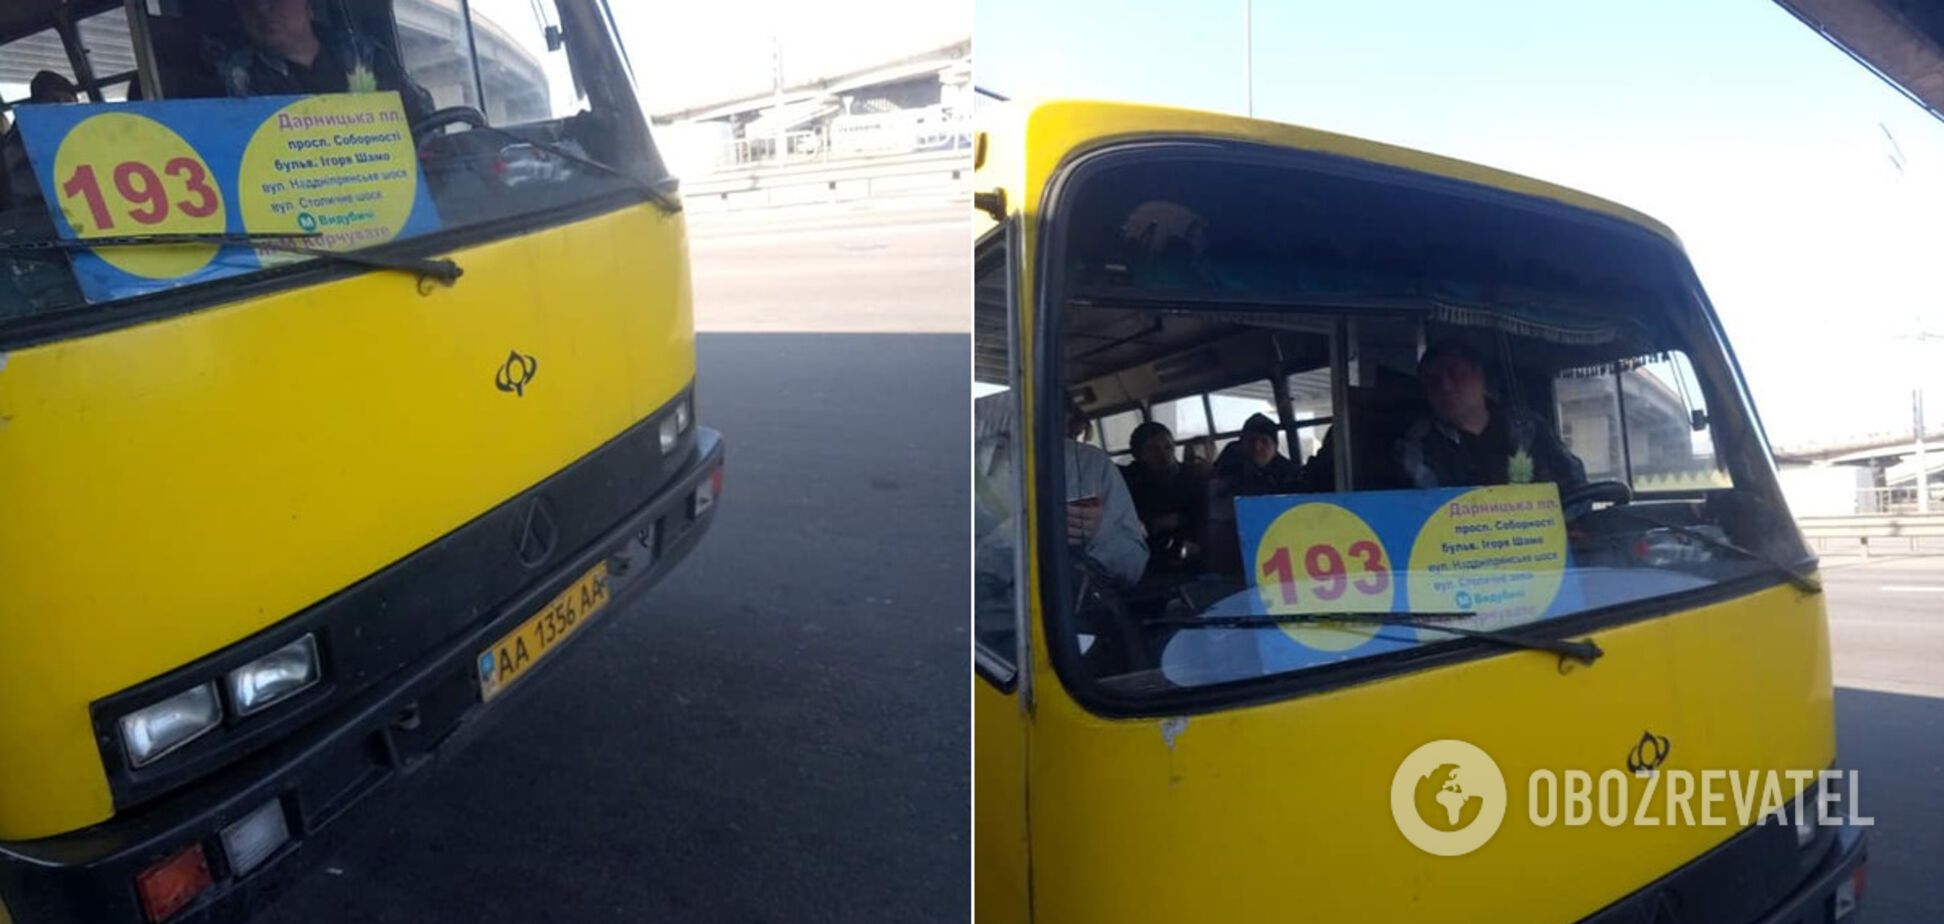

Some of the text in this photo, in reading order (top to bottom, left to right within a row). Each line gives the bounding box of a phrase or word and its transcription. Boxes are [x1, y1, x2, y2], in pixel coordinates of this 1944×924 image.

[278, 110, 403, 131] Дарницька пл.
[288, 129, 401, 151] просп. Соборності
[274, 151, 391, 173] бульв. Ігоря Шамо
[63, 156, 219, 231] 193
[1449, 500, 1534, 518] Дарницька
[1455, 518, 1555, 535] просп. Соборності
[1512, 536, 1544, 547] Шамо
[1262, 540, 1390, 606] 193
[498, 574, 605, 681] AA 1356 AA
